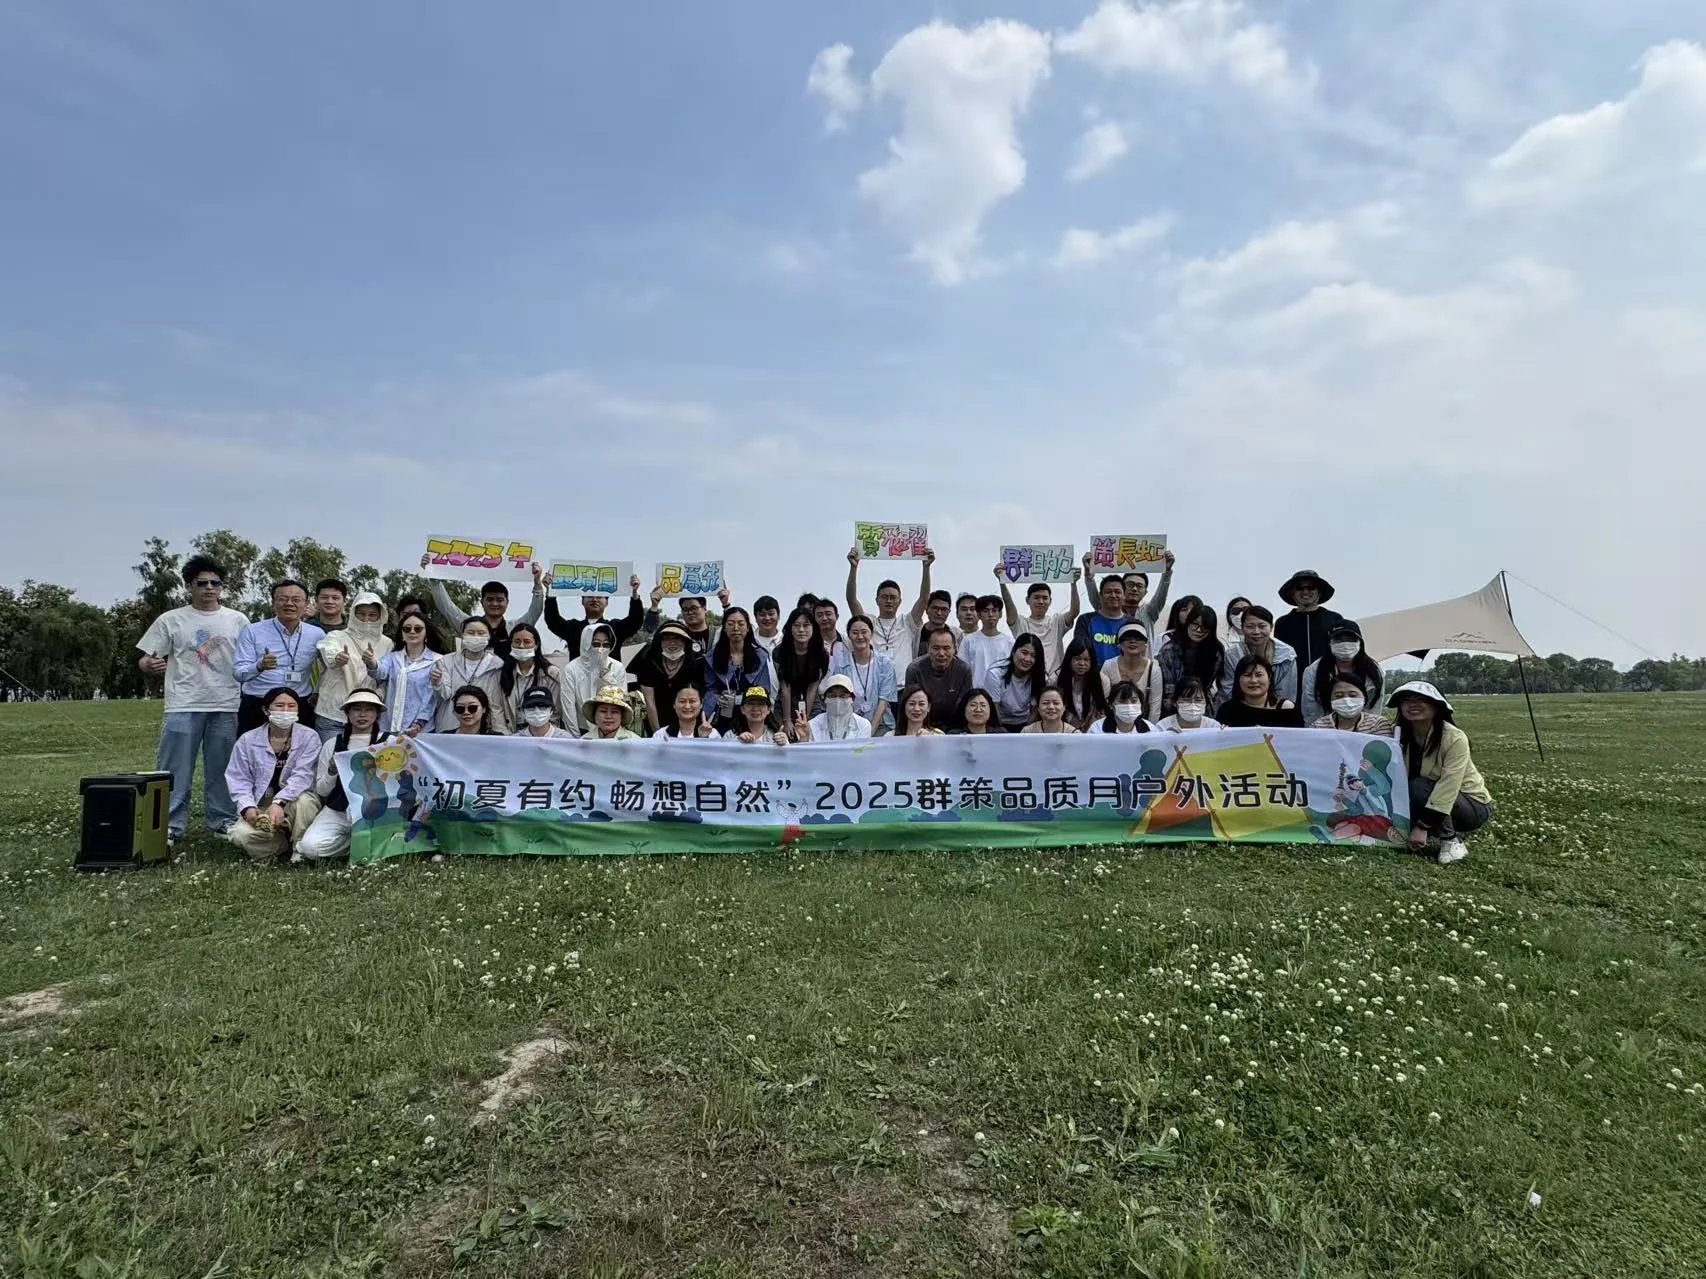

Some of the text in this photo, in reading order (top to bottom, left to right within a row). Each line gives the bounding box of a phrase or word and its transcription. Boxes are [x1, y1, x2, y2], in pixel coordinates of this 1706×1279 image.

[815, 772, 1310, 811] 2025群策品质月户外活动
